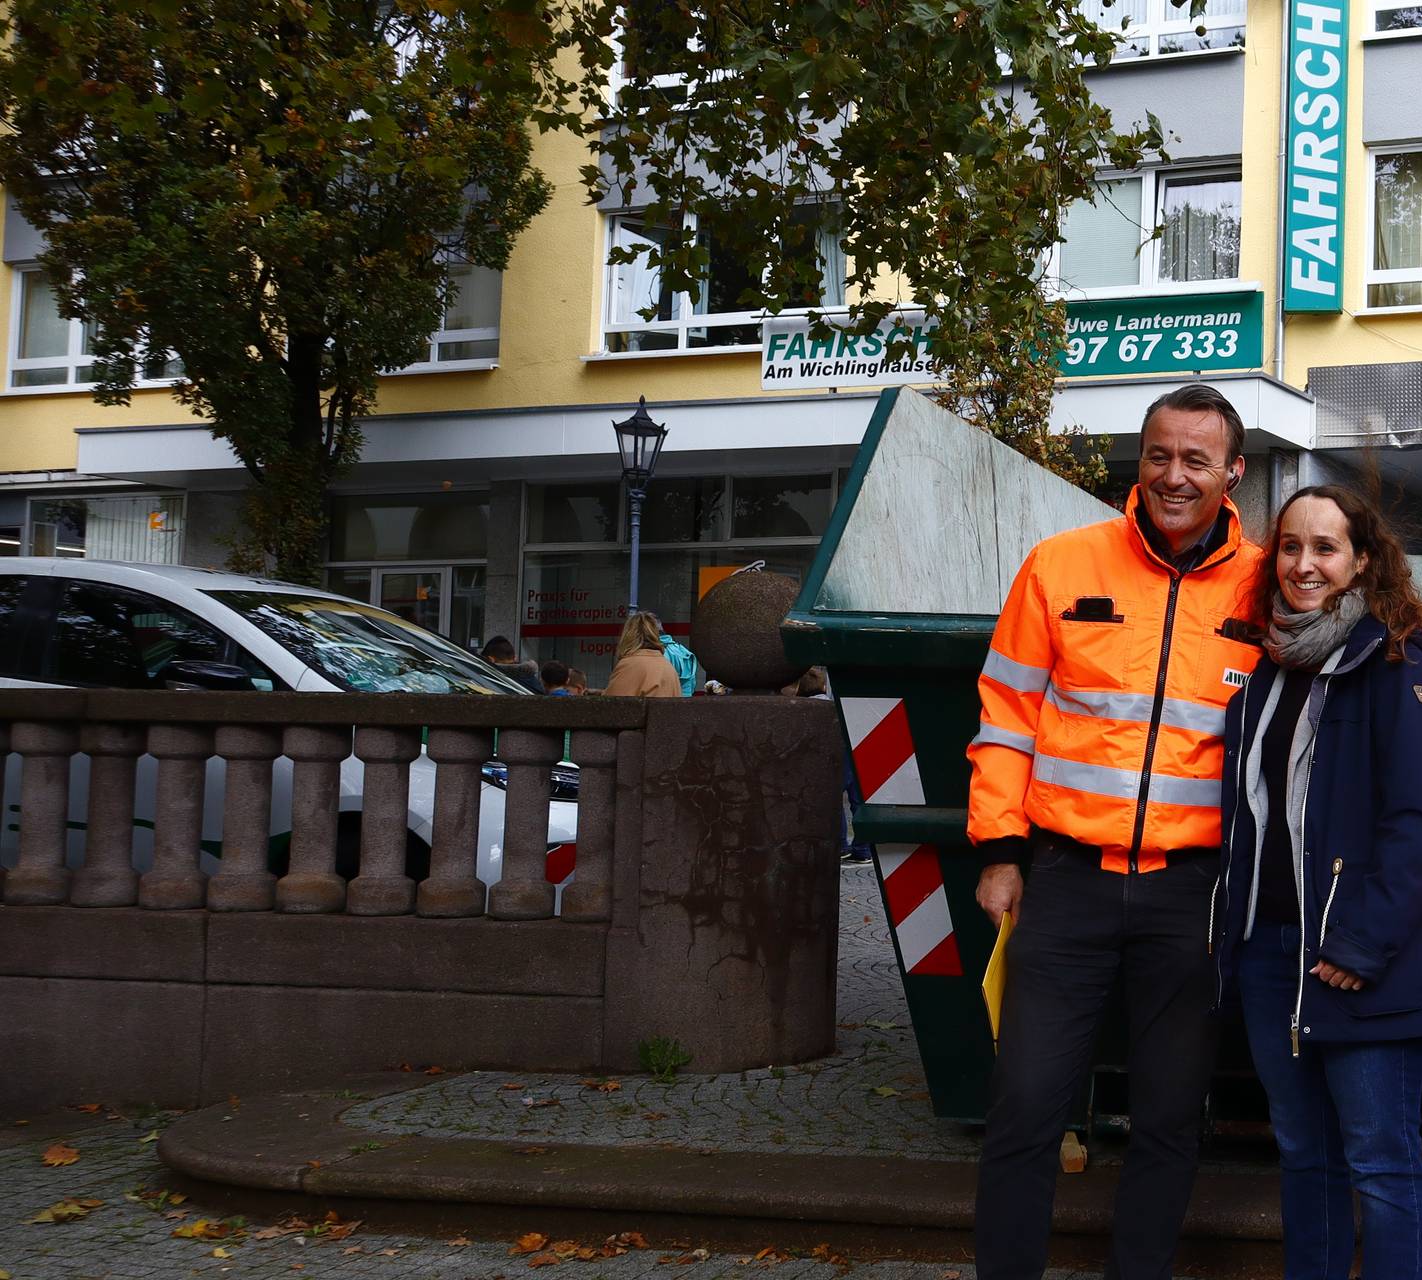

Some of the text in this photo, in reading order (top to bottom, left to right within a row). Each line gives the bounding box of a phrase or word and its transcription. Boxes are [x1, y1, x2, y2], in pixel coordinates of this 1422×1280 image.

[1291, 2, 1341, 296] FAHRSCH
[1066, 312, 1242, 334] Uwe Lantermann
[1065, 330, 1239, 365] 97 67 333
[763, 365, 793, 379] Am
[527, 589, 568, 602] Praxis
[527, 604, 627, 622] Ergotherapie &
